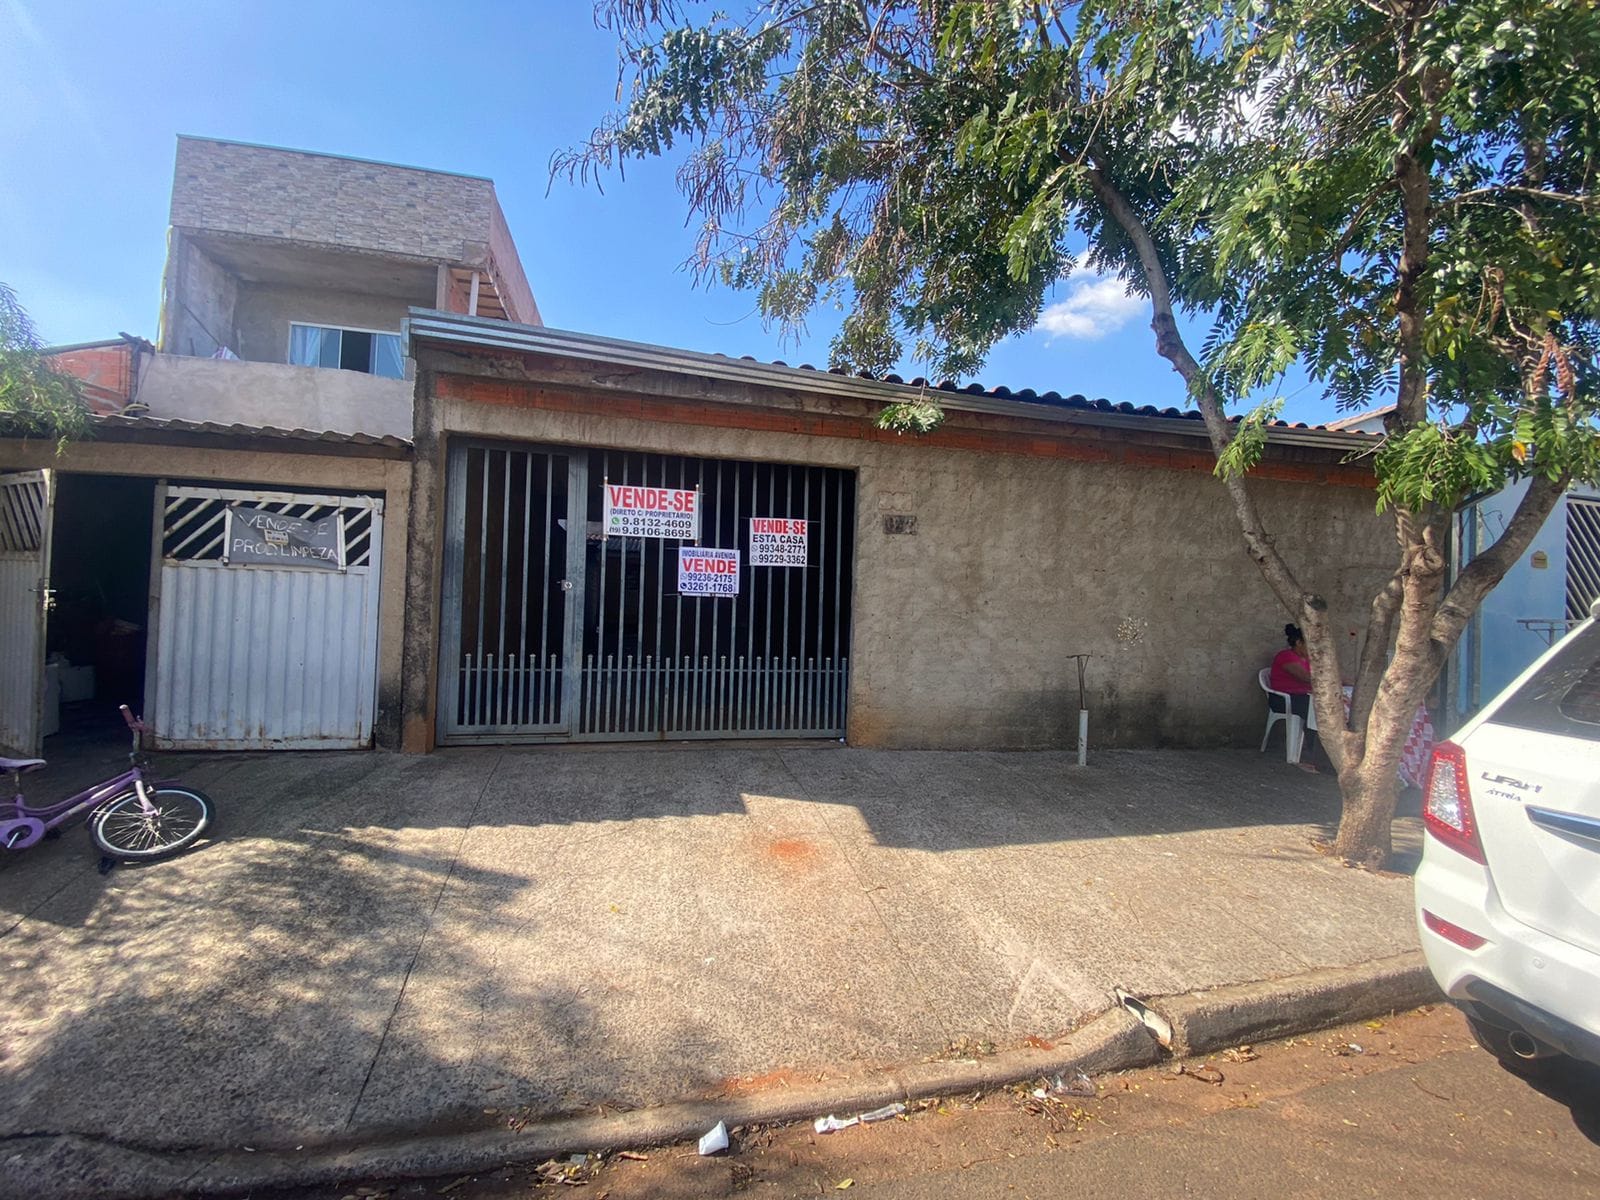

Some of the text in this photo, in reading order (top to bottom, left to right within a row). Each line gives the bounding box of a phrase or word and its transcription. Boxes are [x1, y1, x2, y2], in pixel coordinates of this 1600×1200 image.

[610, 487, 694, 512] VENDE-SE
[610, 508, 637, 516] (DIRETO
[622, 517, 692, 529] 9.8132-4609
[752, 519, 806, 535] VENDE-SE
[609, 526, 692, 538] (19) 9.8106-8695
[753, 534, 804, 544] ESTA CASA
[759, 544, 806, 554] 99348-2771
[683, 558, 736, 574] VENDE
[687, 573, 732, 583] 99236-2175
[687, 582, 733, 592] 3261-1768
